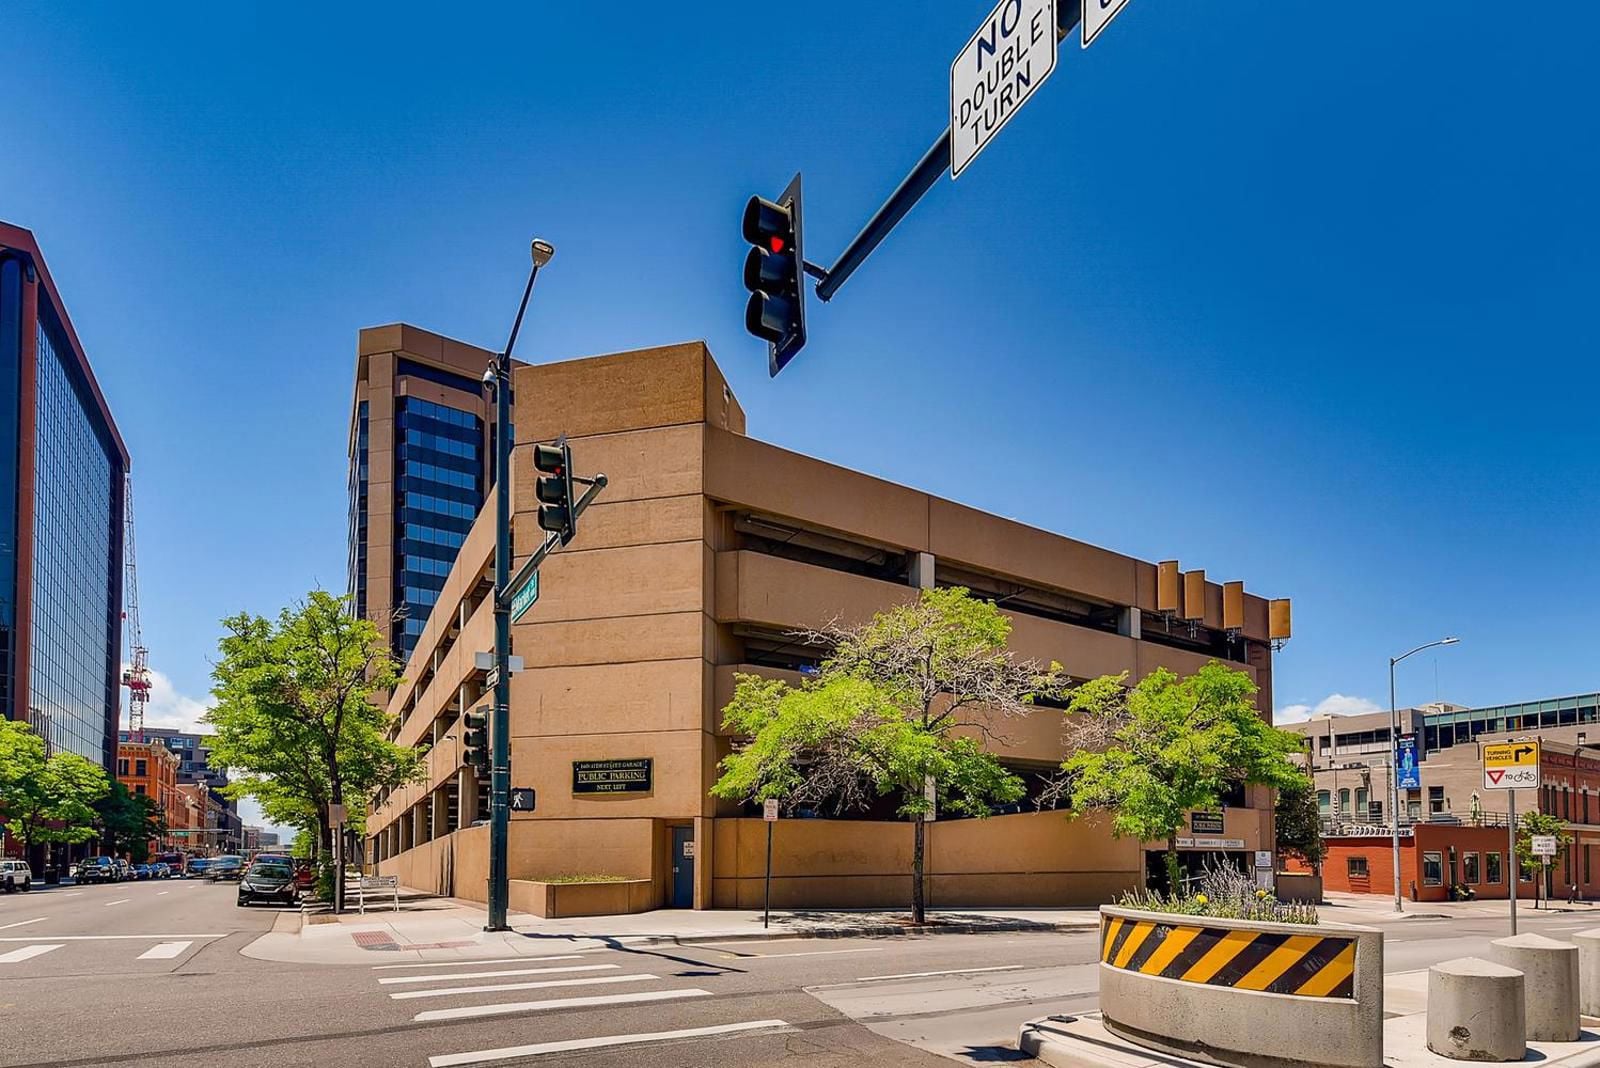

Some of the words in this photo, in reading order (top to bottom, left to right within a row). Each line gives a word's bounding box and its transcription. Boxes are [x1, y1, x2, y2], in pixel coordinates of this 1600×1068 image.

[960, 8, 1044, 129] DOUBLE
[977, 0, 1022, 73] NO
[971, 59, 1031, 145] TURN
[578, 772, 607, 781] PUBLIC
[610, 771, 646, 780] PARKING
